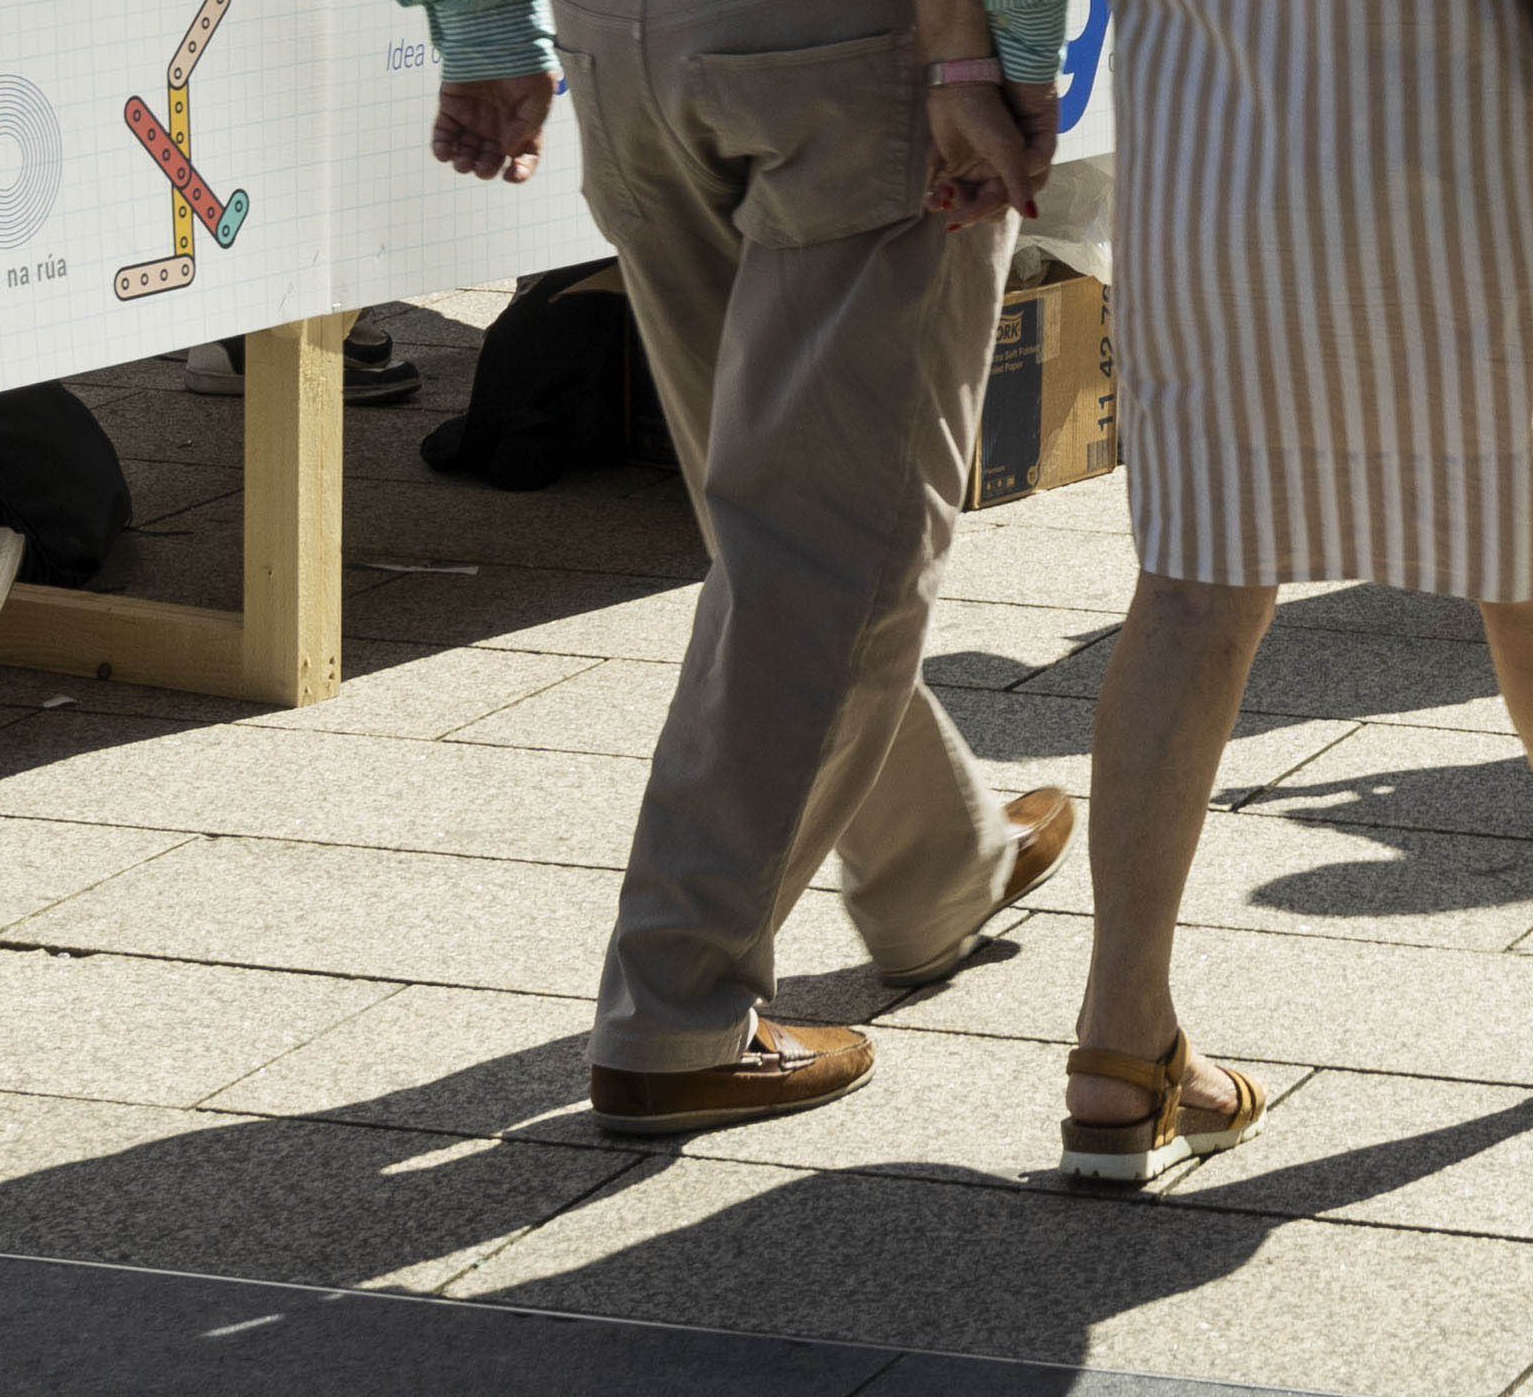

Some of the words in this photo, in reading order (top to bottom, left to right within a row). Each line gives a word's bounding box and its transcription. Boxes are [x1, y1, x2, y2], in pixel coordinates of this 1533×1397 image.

[387, 38, 425, 71] Idea
[8, 265, 29, 288] na
[37, 254, 67, 282] rúa
